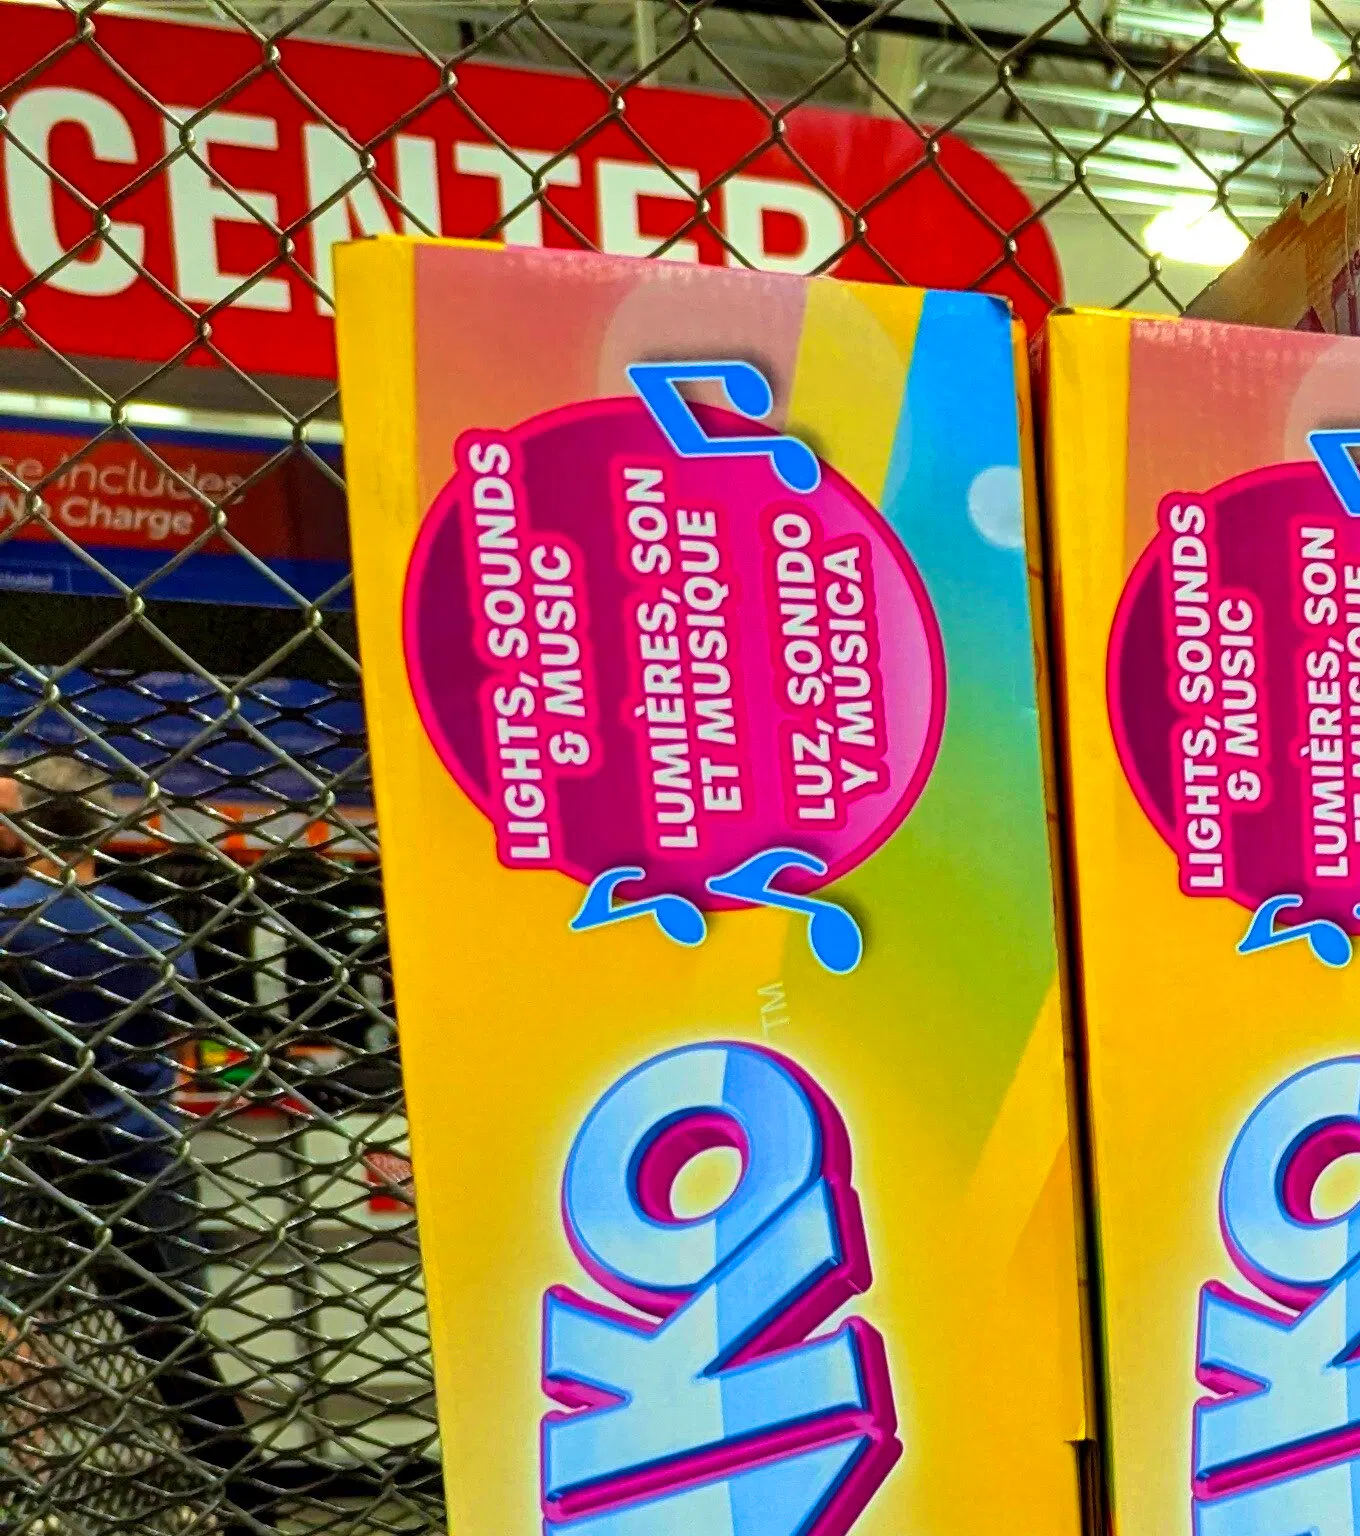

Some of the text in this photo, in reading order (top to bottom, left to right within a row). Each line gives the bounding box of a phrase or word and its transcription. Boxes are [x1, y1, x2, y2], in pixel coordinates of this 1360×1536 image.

[60, 496, 193, 540] Charge
[470, 441, 550, 859] LIGHTS, SOUNDS
[531, 545, 589, 766] & MUSIC
[624, 469, 697, 849] LUMIÈRES, SON
[677, 510, 741, 811] ET MUSIQUE
[773, 514, 833, 819] LUZ, SONIDO
[822, 546, 878, 792] Y MÚSICA
